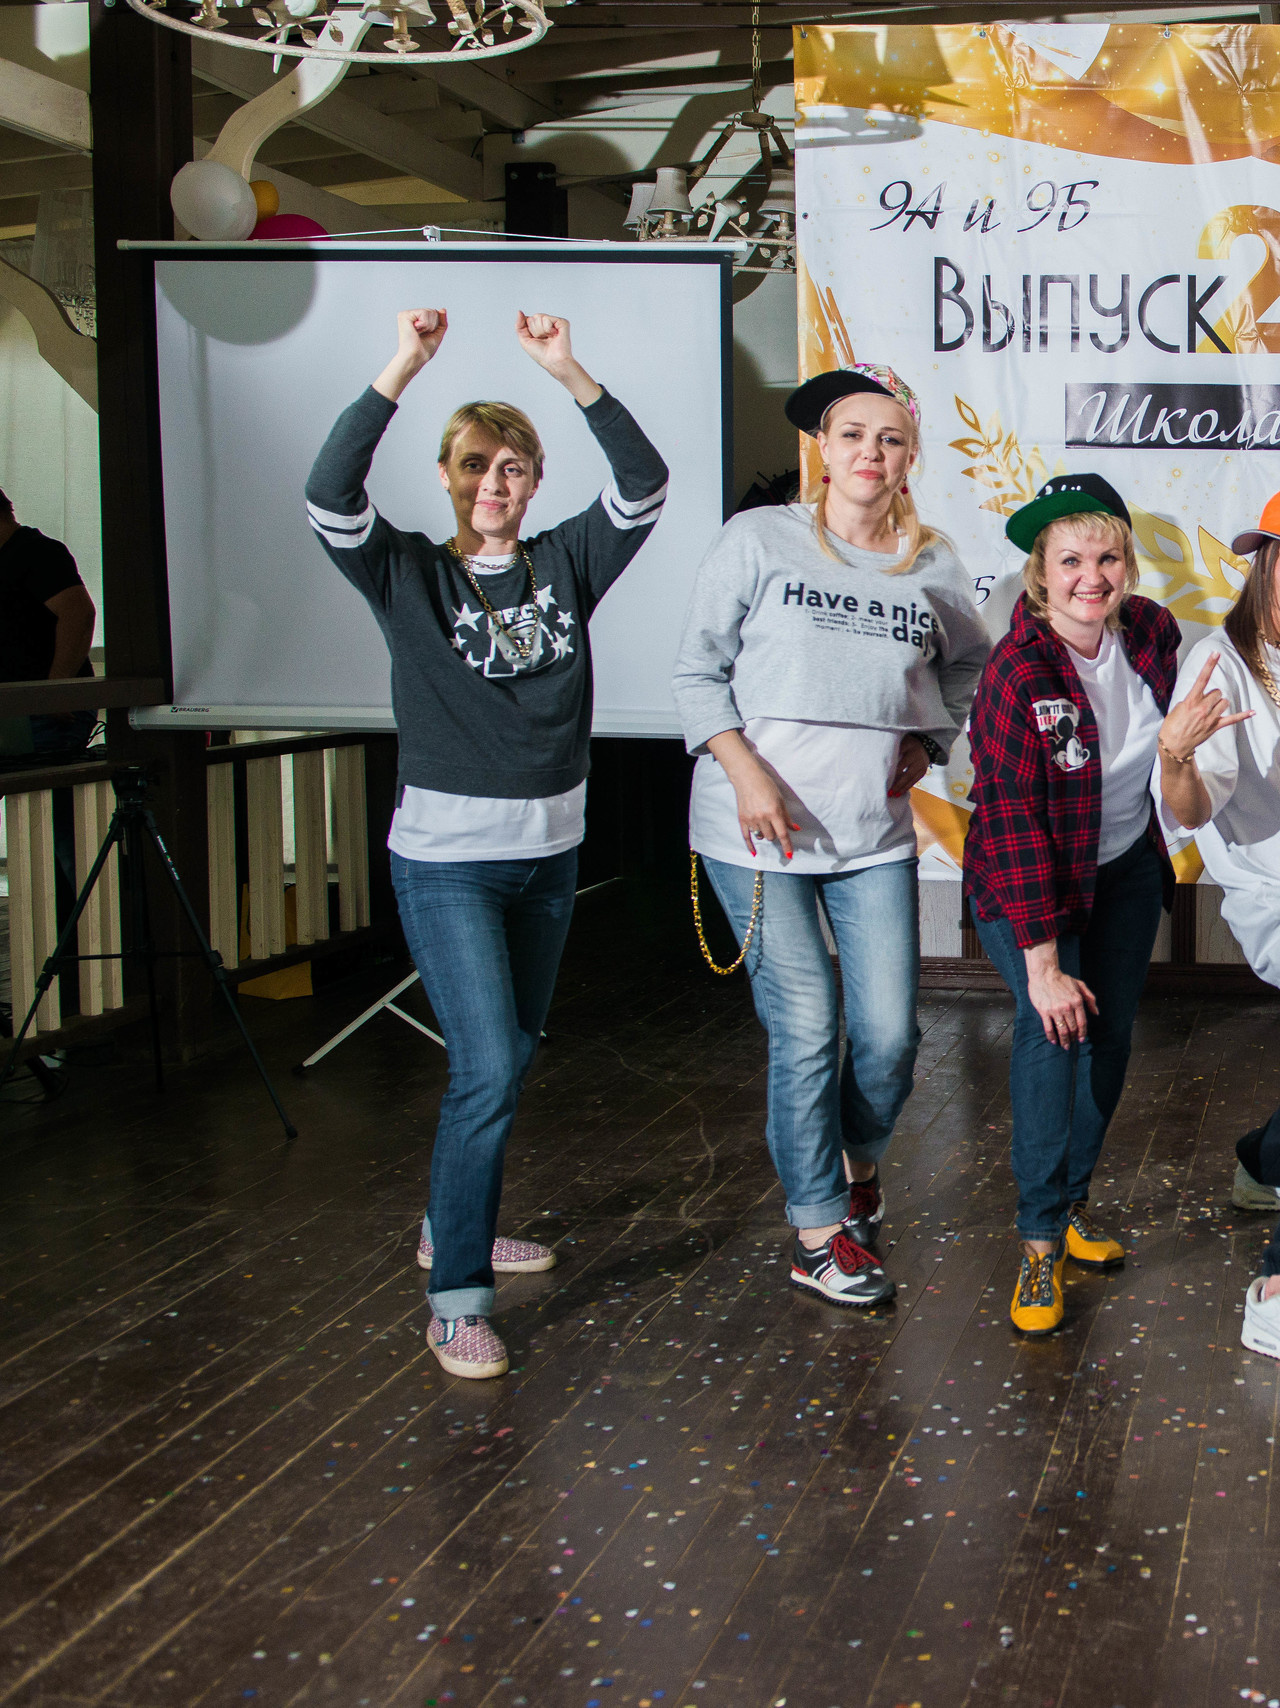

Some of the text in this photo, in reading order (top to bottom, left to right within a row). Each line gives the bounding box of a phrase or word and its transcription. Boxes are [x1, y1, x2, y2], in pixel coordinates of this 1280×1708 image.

[869, 180, 1099, 234] 9А и 9Б
[783, 582, 938, 634] Have a nice
